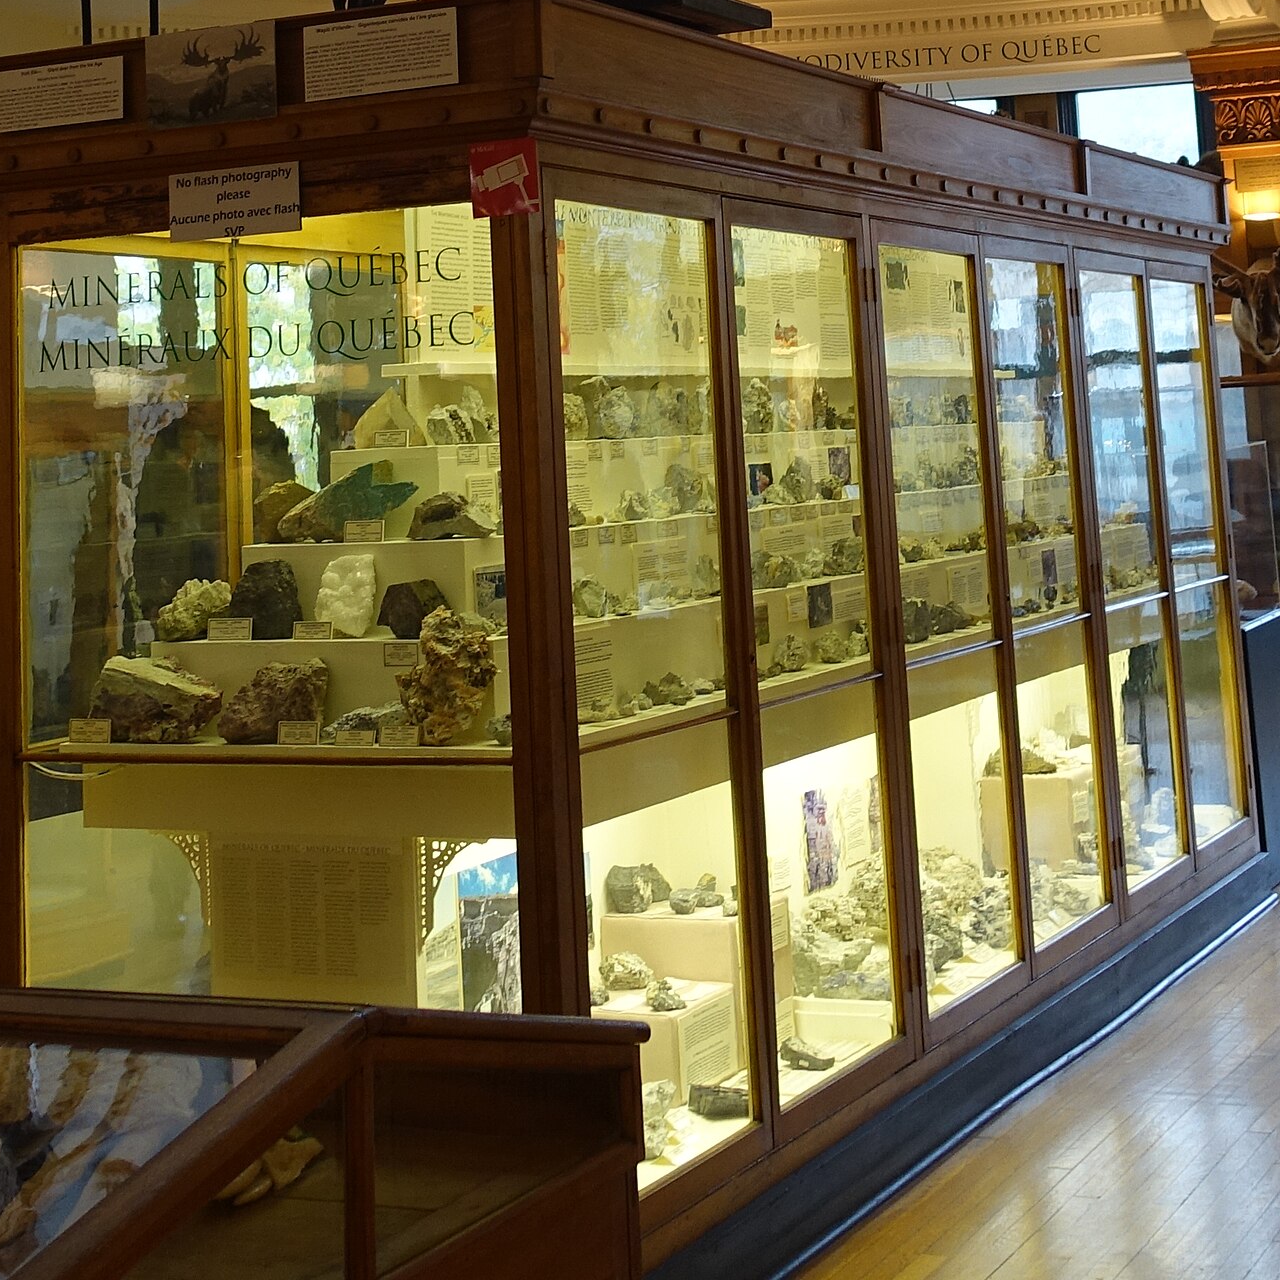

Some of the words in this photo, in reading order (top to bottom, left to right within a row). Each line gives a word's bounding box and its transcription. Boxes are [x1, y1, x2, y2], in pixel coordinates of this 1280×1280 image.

[796, 45, 952, 73] ODIVERSITY
[960, 42, 994, 65] OF
[1000, 33, 1102, 65] QUÉBEC
[176, 178, 192, 189] No
[194, 175, 219, 187] flash
[221, 167, 292, 187] photography
[216, 190, 251, 204] please
[170, 214, 211, 226] Aucune
[212, 210, 245, 224] photo
[247, 206, 272, 218] avec
[274, 202, 301, 215] flash
[224, 226, 246, 238] SVP
[48, 264, 228, 310] MINERALS
[242, 259, 293, 296] OF
[304, 246, 462, 297] QUÉBEC
[38, 325, 232, 373] MINÉRAUX
[247, 322, 302, 359] DU
[317, 308, 477, 360] QUÉBEC
